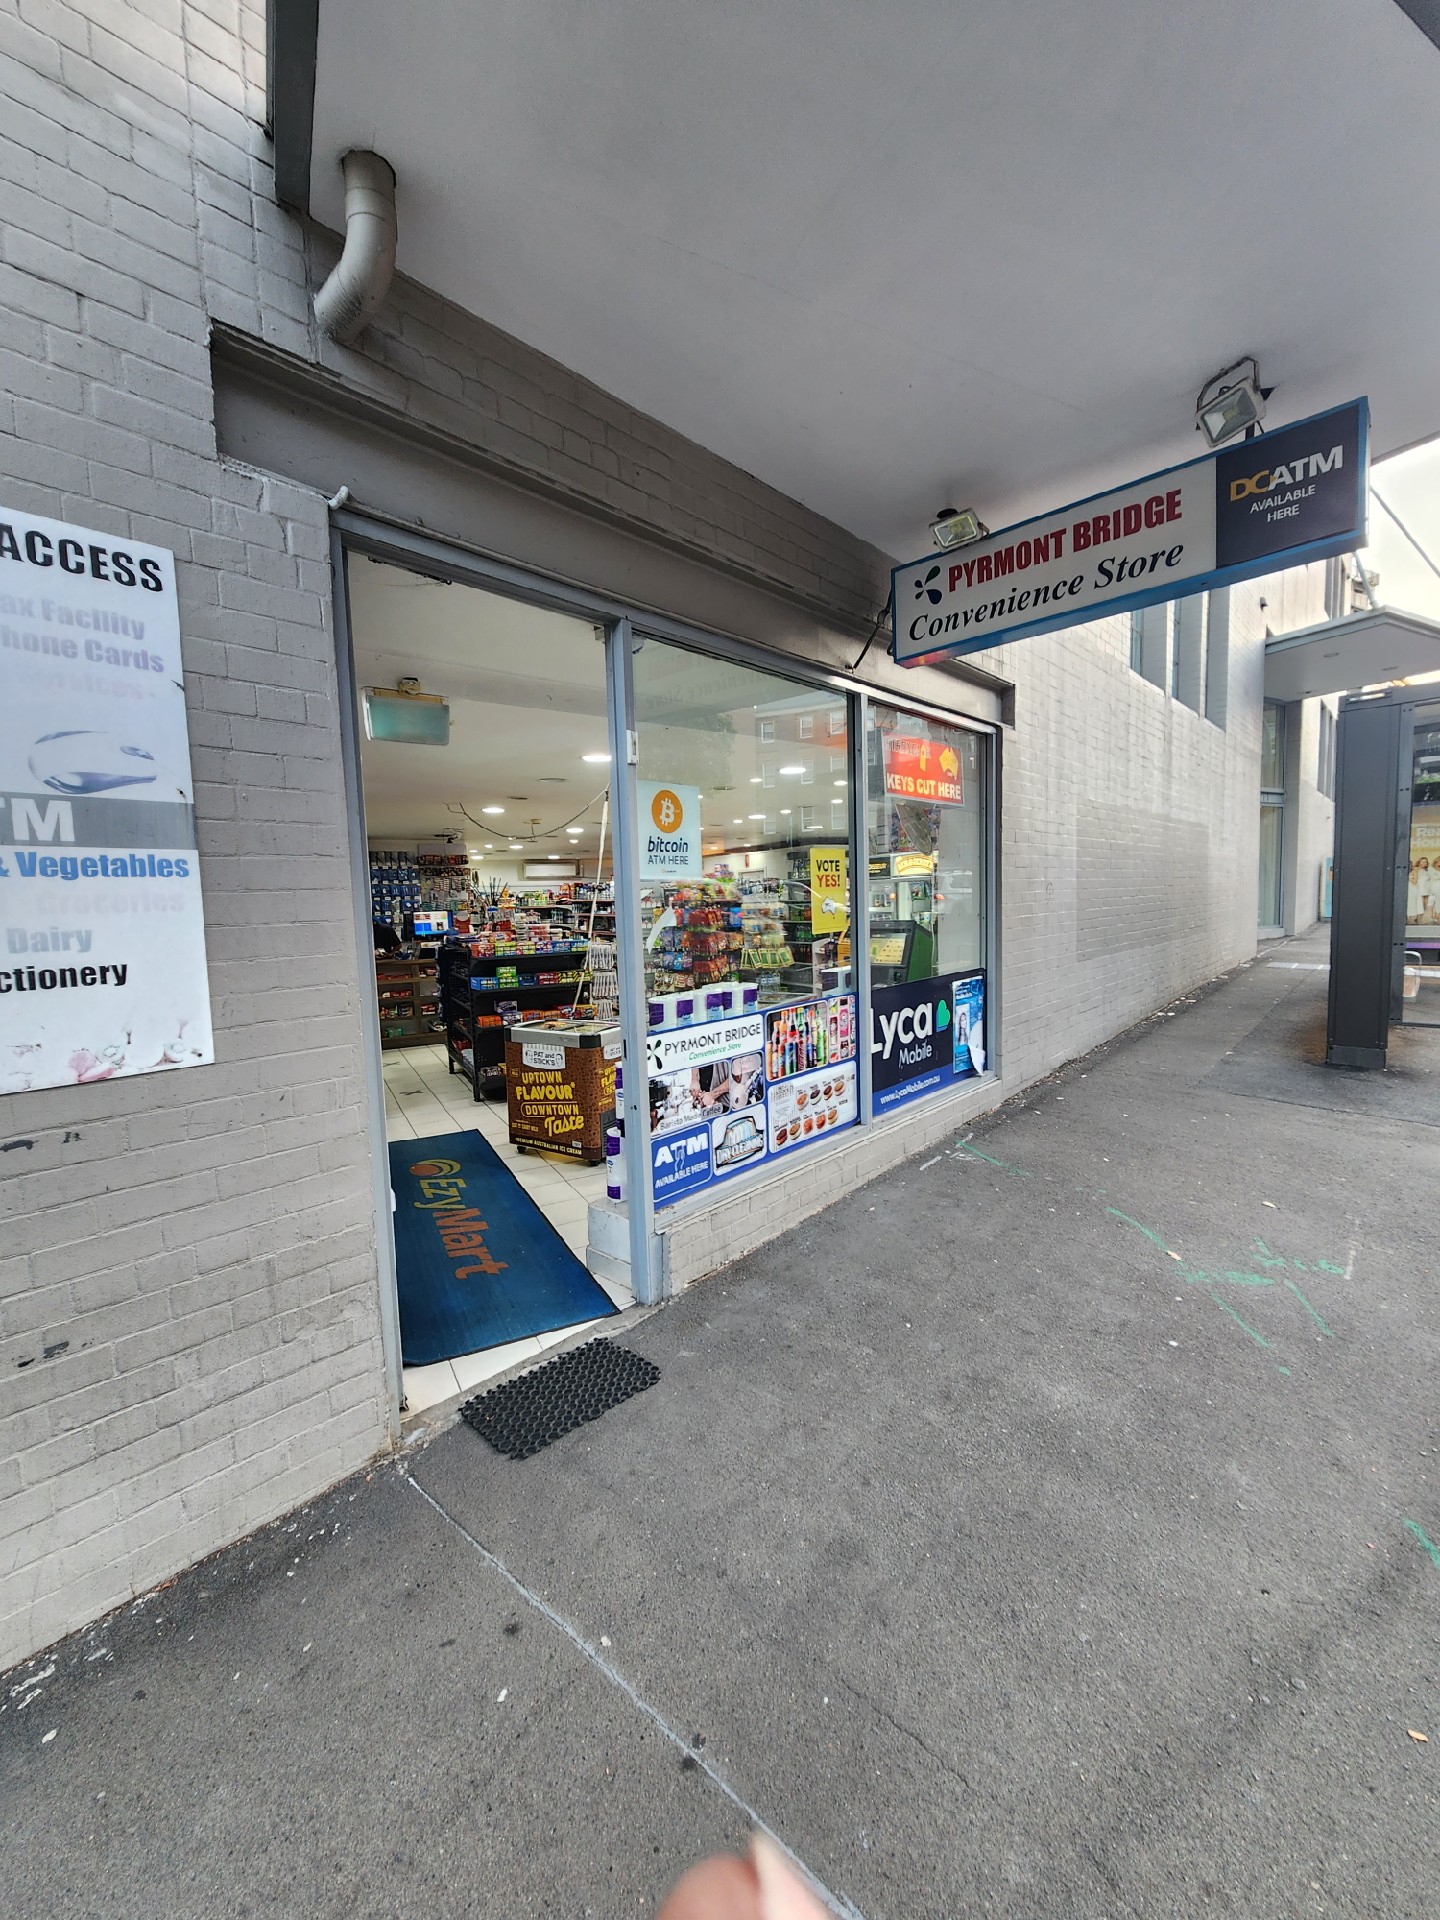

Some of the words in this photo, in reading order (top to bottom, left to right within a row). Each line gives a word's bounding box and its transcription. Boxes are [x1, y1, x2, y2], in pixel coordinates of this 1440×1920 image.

[1250, 485, 1316, 514] AVAILABLE
[1267, 504, 1300, 522] HERE
[948, 528, 1066, 592] PYRMONT
[1073, 489, 1182, 552] BRIDGE
[0, 522, 163, 592] ACCESS
[909, 574, 1084, 641] Convenience
[1094, 544, 1184, 590] Store
[41, 598, 145, 640] Facility
[84, 638, 164, 673] Cards
[887, 773, 915, 792] KEYS
[917, 779, 936, 795] CUT
[938, 782, 961, 799] HERE
[647, 836, 689, 853] bitcoin
[14, 852, 190, 881] Vegetables
[648, 855, 666, 865] ATM
[668, 855, 689, 866] HERE
[816, 859, 840, 873] VOTE
[817, 874, 841, 888] YES!
[6, 927, 93, 954] Dairy
[664, 1032, 722, 1056] PYRMONT
[725, 1023, 761, 1042] BRIDGE
[688, 1046, 727, 1061] Convenience
[728, 1042, 742, 1052] Store
[899, 1041, 933, 1065] Mobile
[522, 1071, 562, 1084] UPTOWN
[525, 1104, 579, 1115] DOWNTOWN
[660, 1116, 683, 1130] Barista
[702, 1105, 721, 1117] Coffee
[544, 1115, 584, 1137] Taste
[654, 1132, 709, 1168] ATM
[655, 1167, 691, 1188] AVAILABLE
[690, 1160, 709, 1174] HERE
